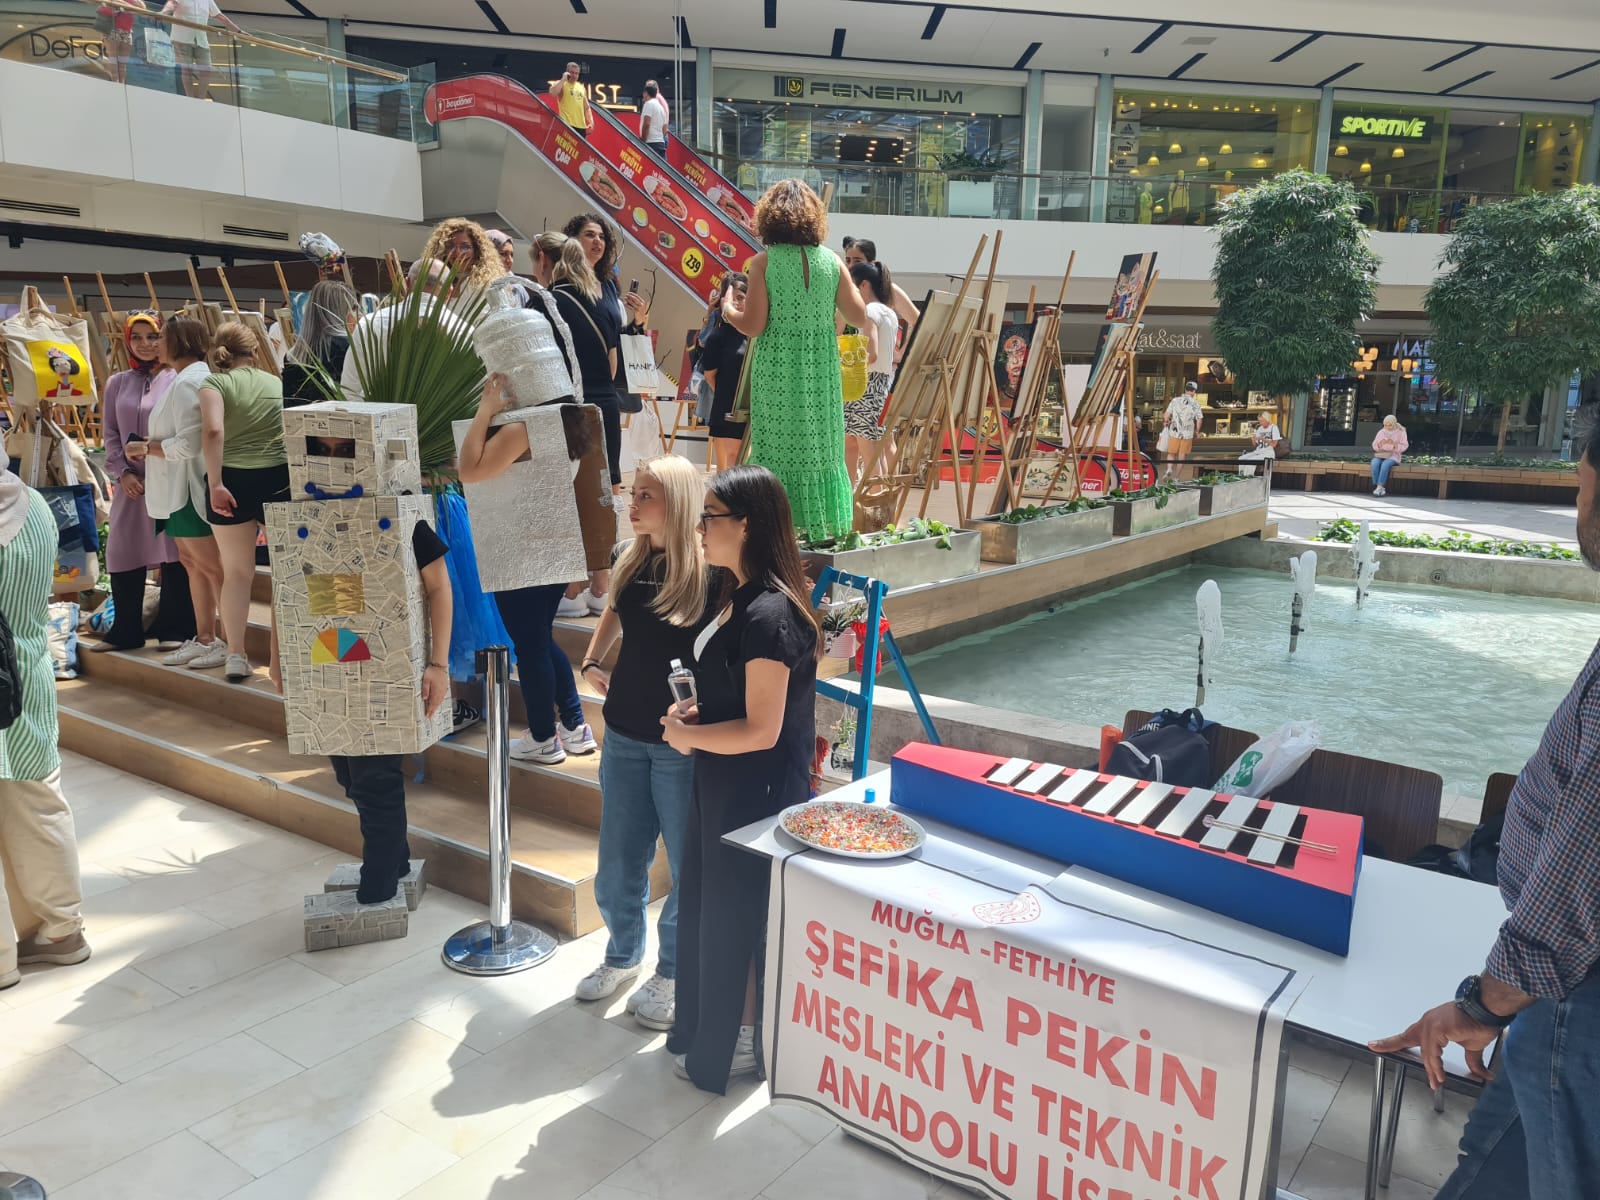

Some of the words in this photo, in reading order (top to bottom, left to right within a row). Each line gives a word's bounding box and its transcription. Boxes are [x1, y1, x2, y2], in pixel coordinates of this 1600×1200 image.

[547, 80, 622, 104] IST
[810, 81, 963, 105] FENERIUM
[1340, 116, 1427, 137] SPORTIVE
[685, 254, 702, 273] 239
[871, 900, 971, 955] MUĞLA
[805, 920, 984, 1034] ŞEFİKA
[1006, 996, 1218, 1121] PEKİN
[792, 982, 947, 1092] MESLEKİ
[962, 1053, 1015, 1122] VE
[1031, 1084, 1229, 1200] TEKNİK
[817, 1055, 1018, 1187] ANADOLU
